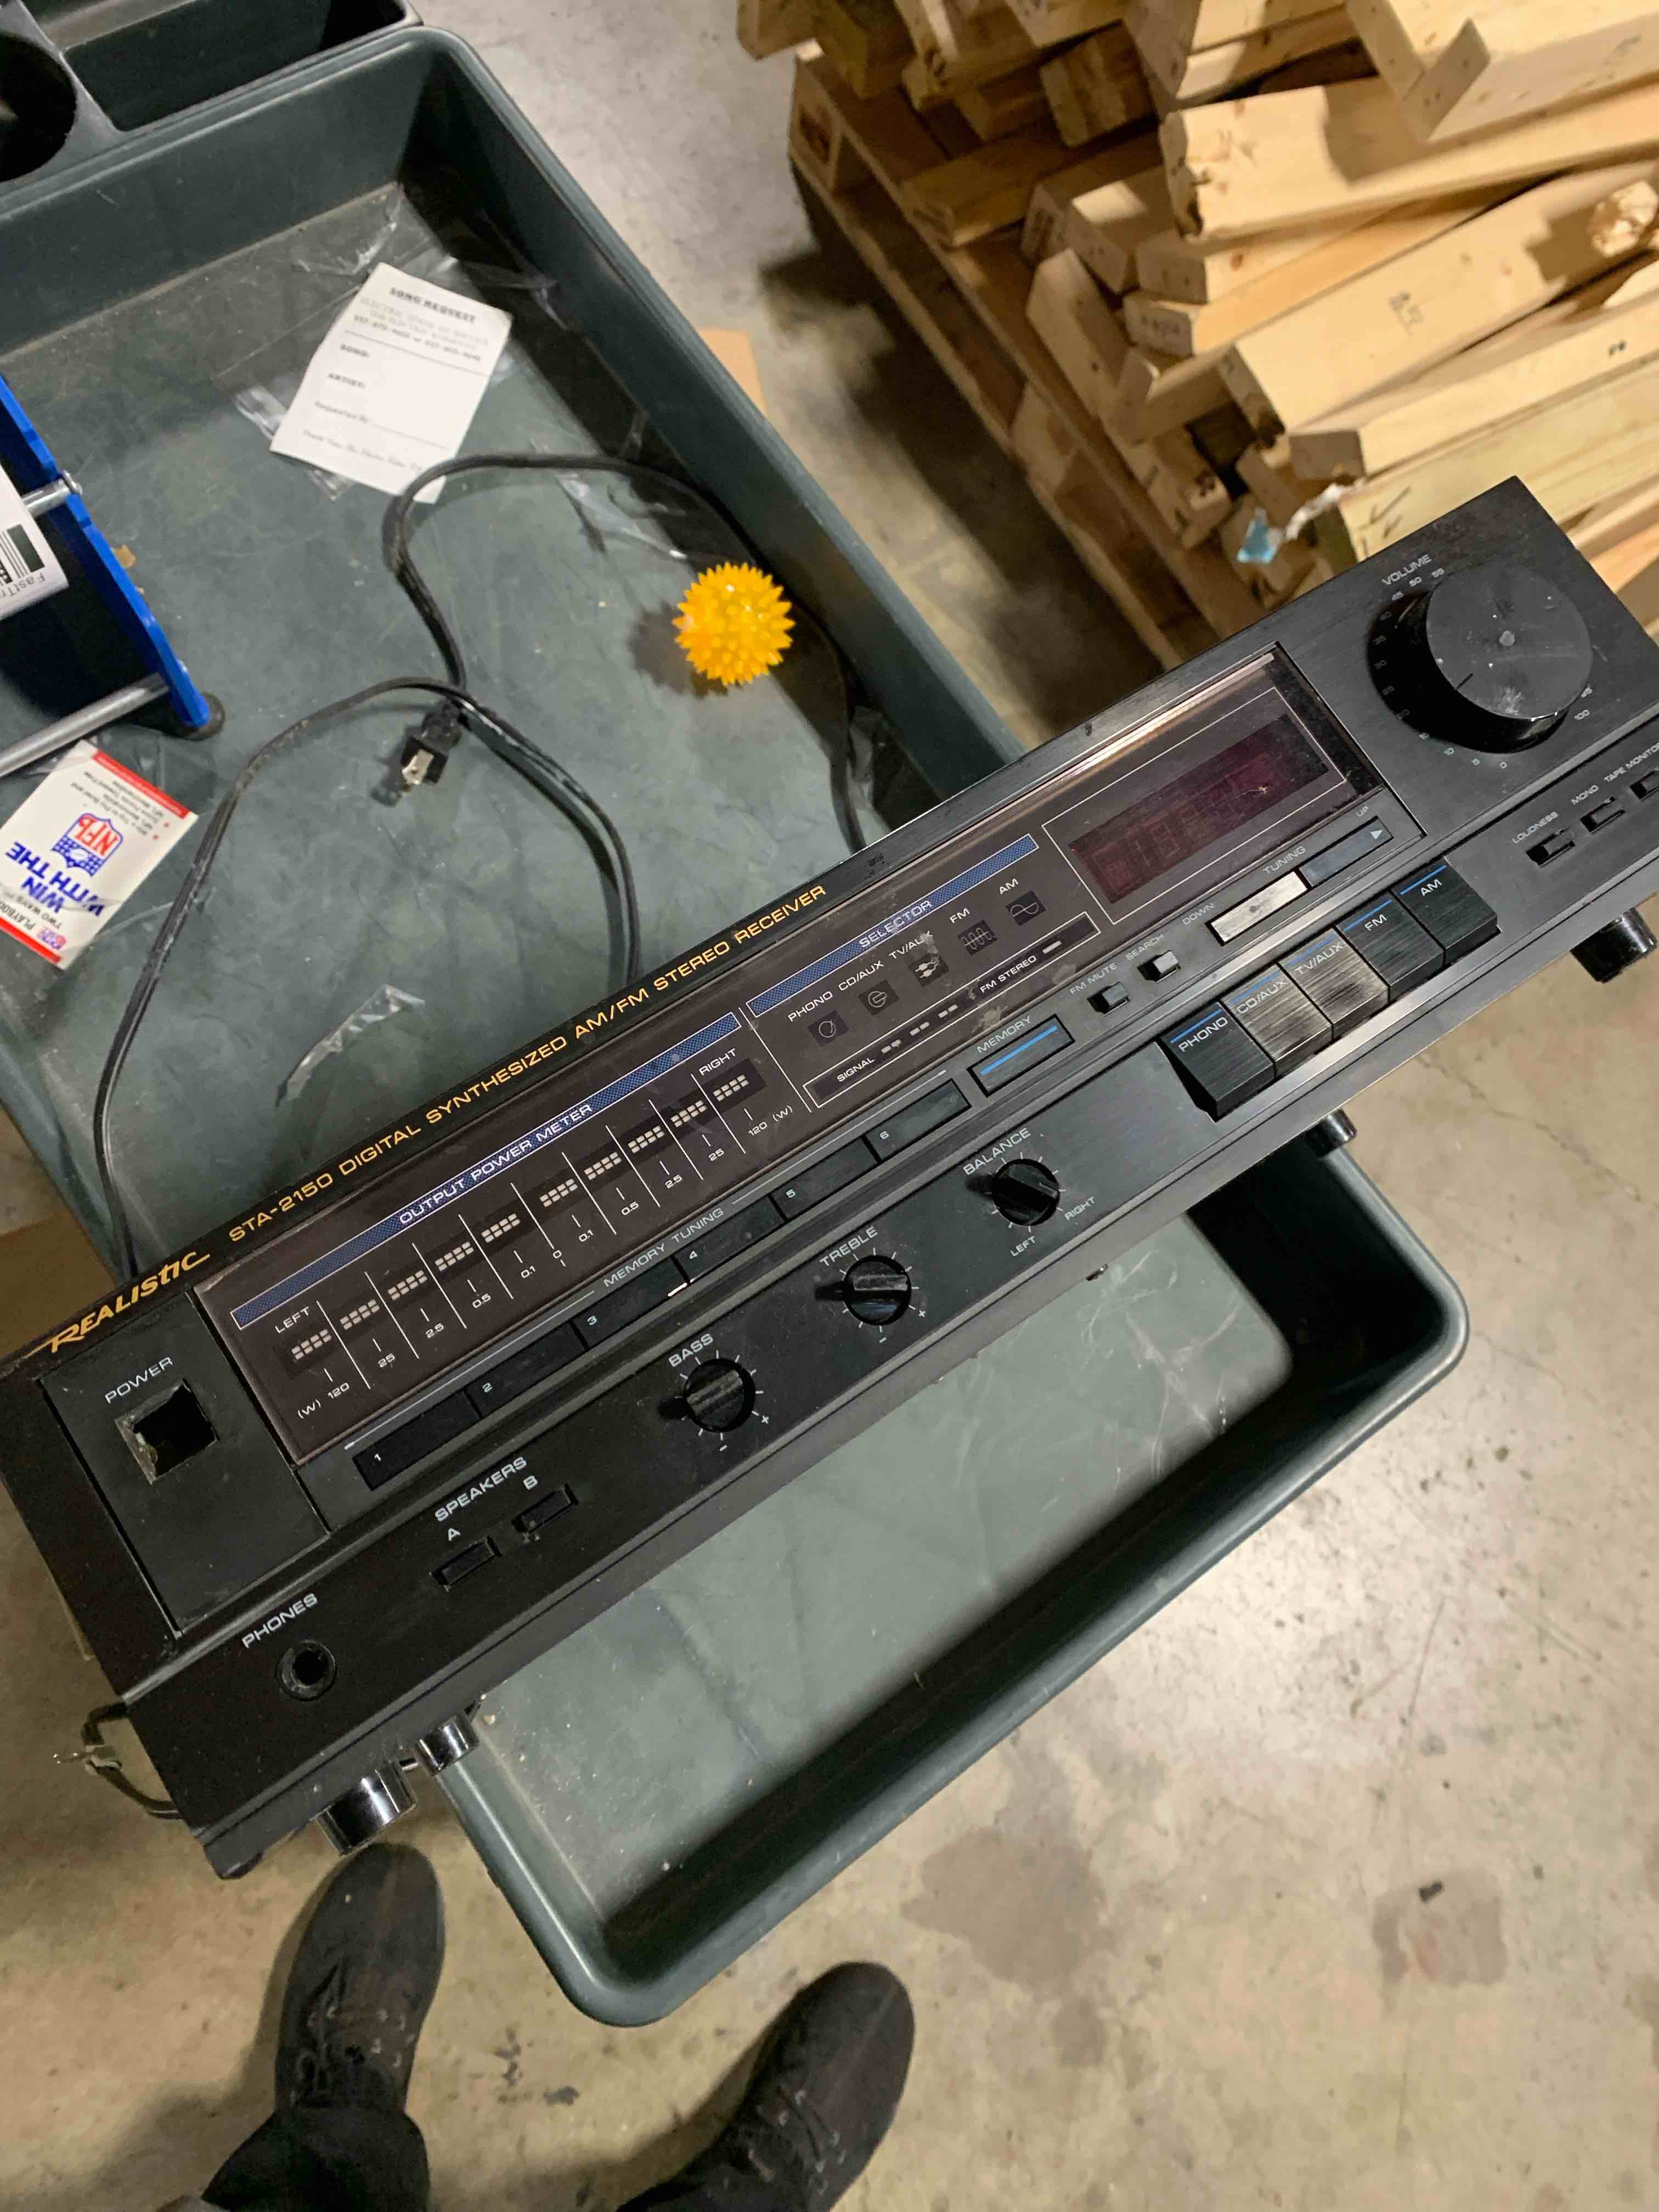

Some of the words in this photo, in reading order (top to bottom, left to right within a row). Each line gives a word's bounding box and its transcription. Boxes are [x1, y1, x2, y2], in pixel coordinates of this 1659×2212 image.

[1381, 554, 1432, 586] VOLUME
[1408, 575, 1423, 588] 50
[1573, 709, 1590, 721] 100
[1604, 766, 1627, 783] TAPE
[1571, 784, 1599, 805] MONO
[1356, 805, 1369, 817] UP
[70, 811, 121, 857] NFL
[1512, 811, 1559, 844] LOUDNESS
[4, 839, 51, 879] THE
[1262, 845, 1306, 875] TUNING
[19, 874, 66, 913] WIN
[48, 869, 107, 916] WITH
[1420, 878, 1442, 896] AM
[15, 895, 41, 915] WAYS
[41, 912, 63, 929] TWO
[1182, 902, 1216, 926] DOWN
[859, 900, 933, 949] SELECTOR
[1364, 913, 1387, 932] FM
[787, 990, 833, 1022] PHONO
[838, 960, 884, 991] CD/AUX
[950, 907, 970, 924] FM
[998, 878, 1019, 895] AM
[1125, 933, 1165, 961] SEARCH
[1294, 940, 1345, 976] TV/AUX
[979, 979, 997, 994] FM
[997, 955, 1037, 982] STEREO
[1069, 981, 1088, 995] FM
[1087, 962, 1118, 984] MUTE
[1236, 977, 1288, 1014] CD/AUX
[976, 1015, 1031, 1054] MEMORY
[1178, 1016, 1228, 1052] PHONO
[228, 1172, 334, 1242] STA-2150
[338, 1122, 421, 1176] DIGITAL
[425, 1035, 567, 1124] SYNTHESIZED
[573, 987, 649, 1039] AM/FM
[653, 940, 730, 991] STEREO
[733, 884, 826, 944] RECEIVER
[698, 1047, 737, 1076] RIGHT
[837, 1056, 875, 1082] SIGNAL
[879, 1130, 889, 1139] 6
[399, 1177, 466, 1224] OUTPUT
[470, 1139, 533, 1181] POWER
[535, 1103, 593, 1142] METER
[962, 1127, 1031, 1176] BALANCE
[786, 1188, 796, 1199] 5
[1064, 1195, 1096, 1221] RIGHT
[297, 1398, 321, 1419] (W)
[327, 1382, 350, 1400] 120
[377, 1352, 396, 1368] 25
[425, 1322, 444, 1339] 2.5
[472, 1293, 491, 1309] 0.5
[520, 1265, 536, 1278] 0.1
[552, 1249, 562, 1259] 0
[578, 1229, 594, 1242] 0.1
[620, 1200, 639, 1216] 0.5
[664, 1173, 683, 1189] 2.5
[708, 1147, 724, 1161] 25
[748, 1121, 768, 1136] 120
[772, 1104, 793, 1122] (W)
[603, 1243, 666, 1287] MEMORY
[671, 1207, 724, 1244] TUNING
[688, 1250, 698, 1260] 4
[819, 1225, 878, 1267] TREBLE
[1010, 1235, 1036, 1257] LEFT
[45, 1248, 210, 1354] REALISTIC
[275, 1306, 311, 1334] LEFT
[586, 1315, 598, 1326] 3
[668, 1333, 714, 1367] BASS
[104, 1356, 173, 1404] POWER
[482, 1382, 493, 1393] 2
[374, 1453, 381, 1462] 1
[434, 1456, 527, 1522] SPEAKERS
[523, 1475, 538, 1490] B
[446, 1527, 461, 1542] A
[241, 1593, 318, 1649] PHONES
